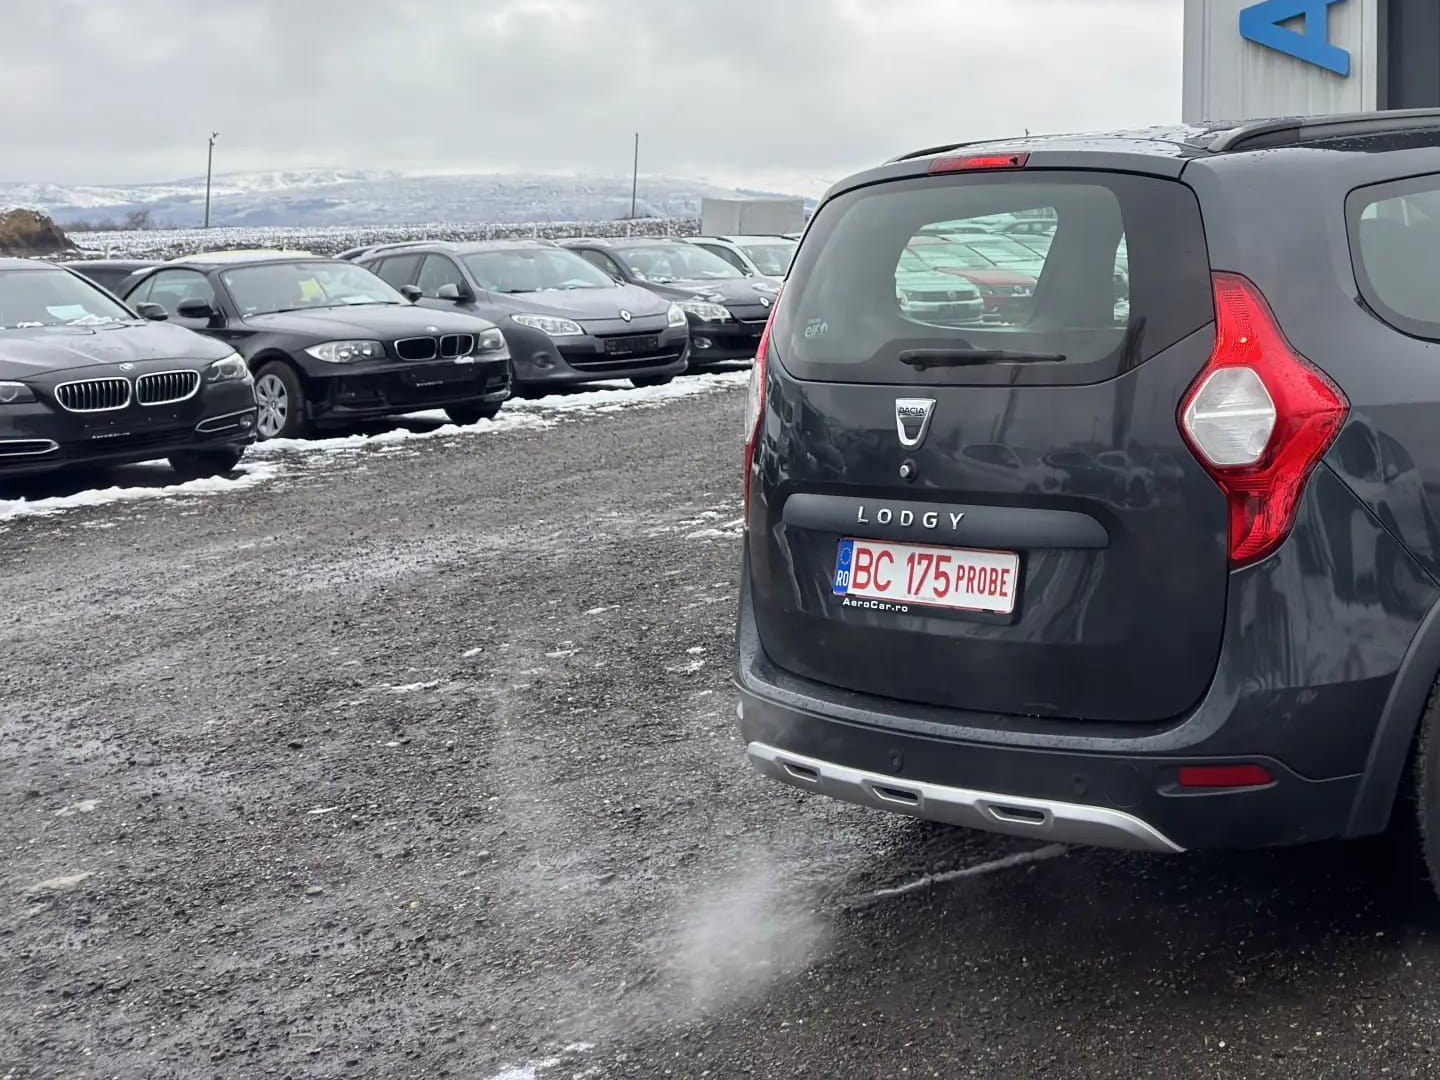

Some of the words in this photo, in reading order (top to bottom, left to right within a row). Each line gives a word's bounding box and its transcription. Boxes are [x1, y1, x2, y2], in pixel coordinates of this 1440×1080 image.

[898, 406, 925, 415] DACIA
[857, 506, 965, 530] LODGY
[835, 570, 850, 587] RO
[851, 547, 894, 592] BC
[906, 551, 952, 598] 175
[955, 564, 1011, 597] PROBE
[842, 597, 909, 613] AeroCar.ro
